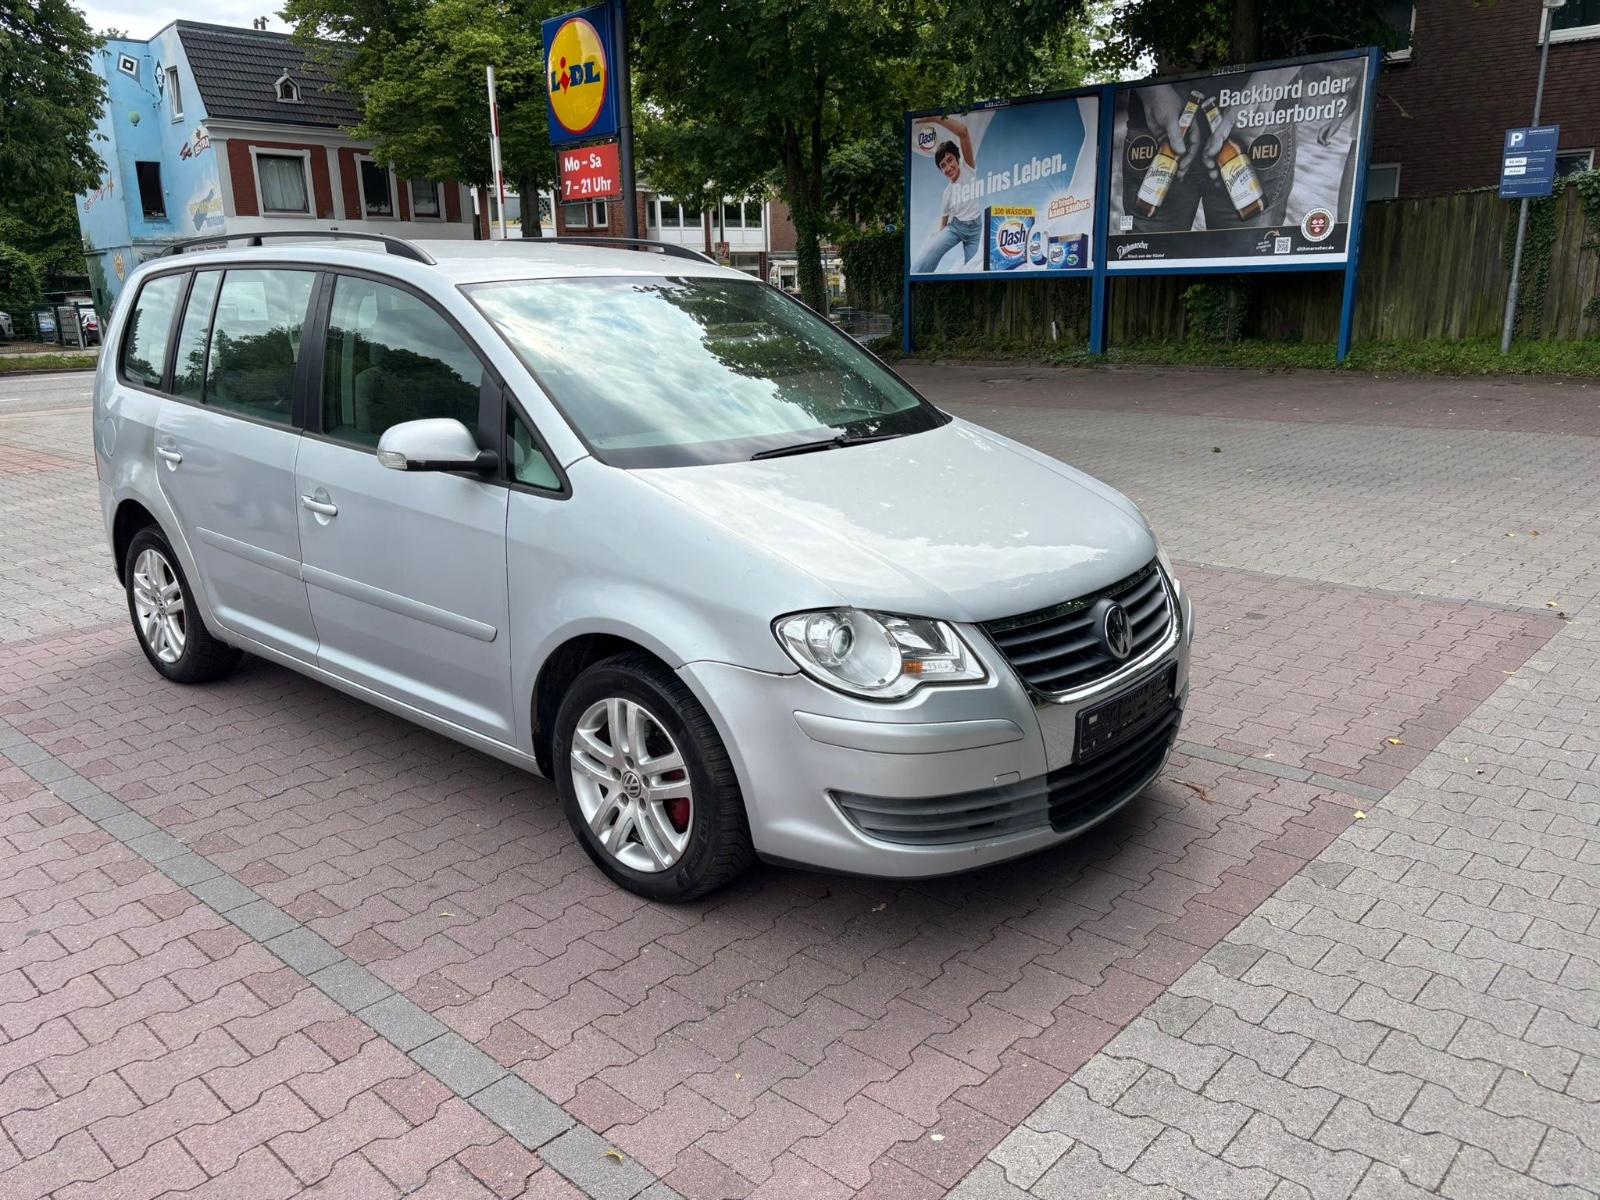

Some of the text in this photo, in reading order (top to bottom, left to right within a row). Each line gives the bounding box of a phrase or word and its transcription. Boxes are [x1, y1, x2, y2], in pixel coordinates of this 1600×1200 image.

[1219, 76, 1350, 108] Backbord oder
[1236, 98, 1348, 129] Steuerbord?
[919, 127, 936, 146] Dash
[1510, 132, 1523, 147] P
[1131, 146, 1154, 161] NEU
[1252, 144, 1279, 160] NEU
[564, 157, 580, 173] Mo
[589, 153, 602, 169] Sa
[565, 181, 571, 196] 7
[580, 178, 591, 194] 21
[592, 177, 612, 192] Uhr
[951, 153, 1067, 206] Rein ins Leben.
[1005, 206, 1032, 215] WÄSCHEN
[1000, 223, 1026, 248] Dash
